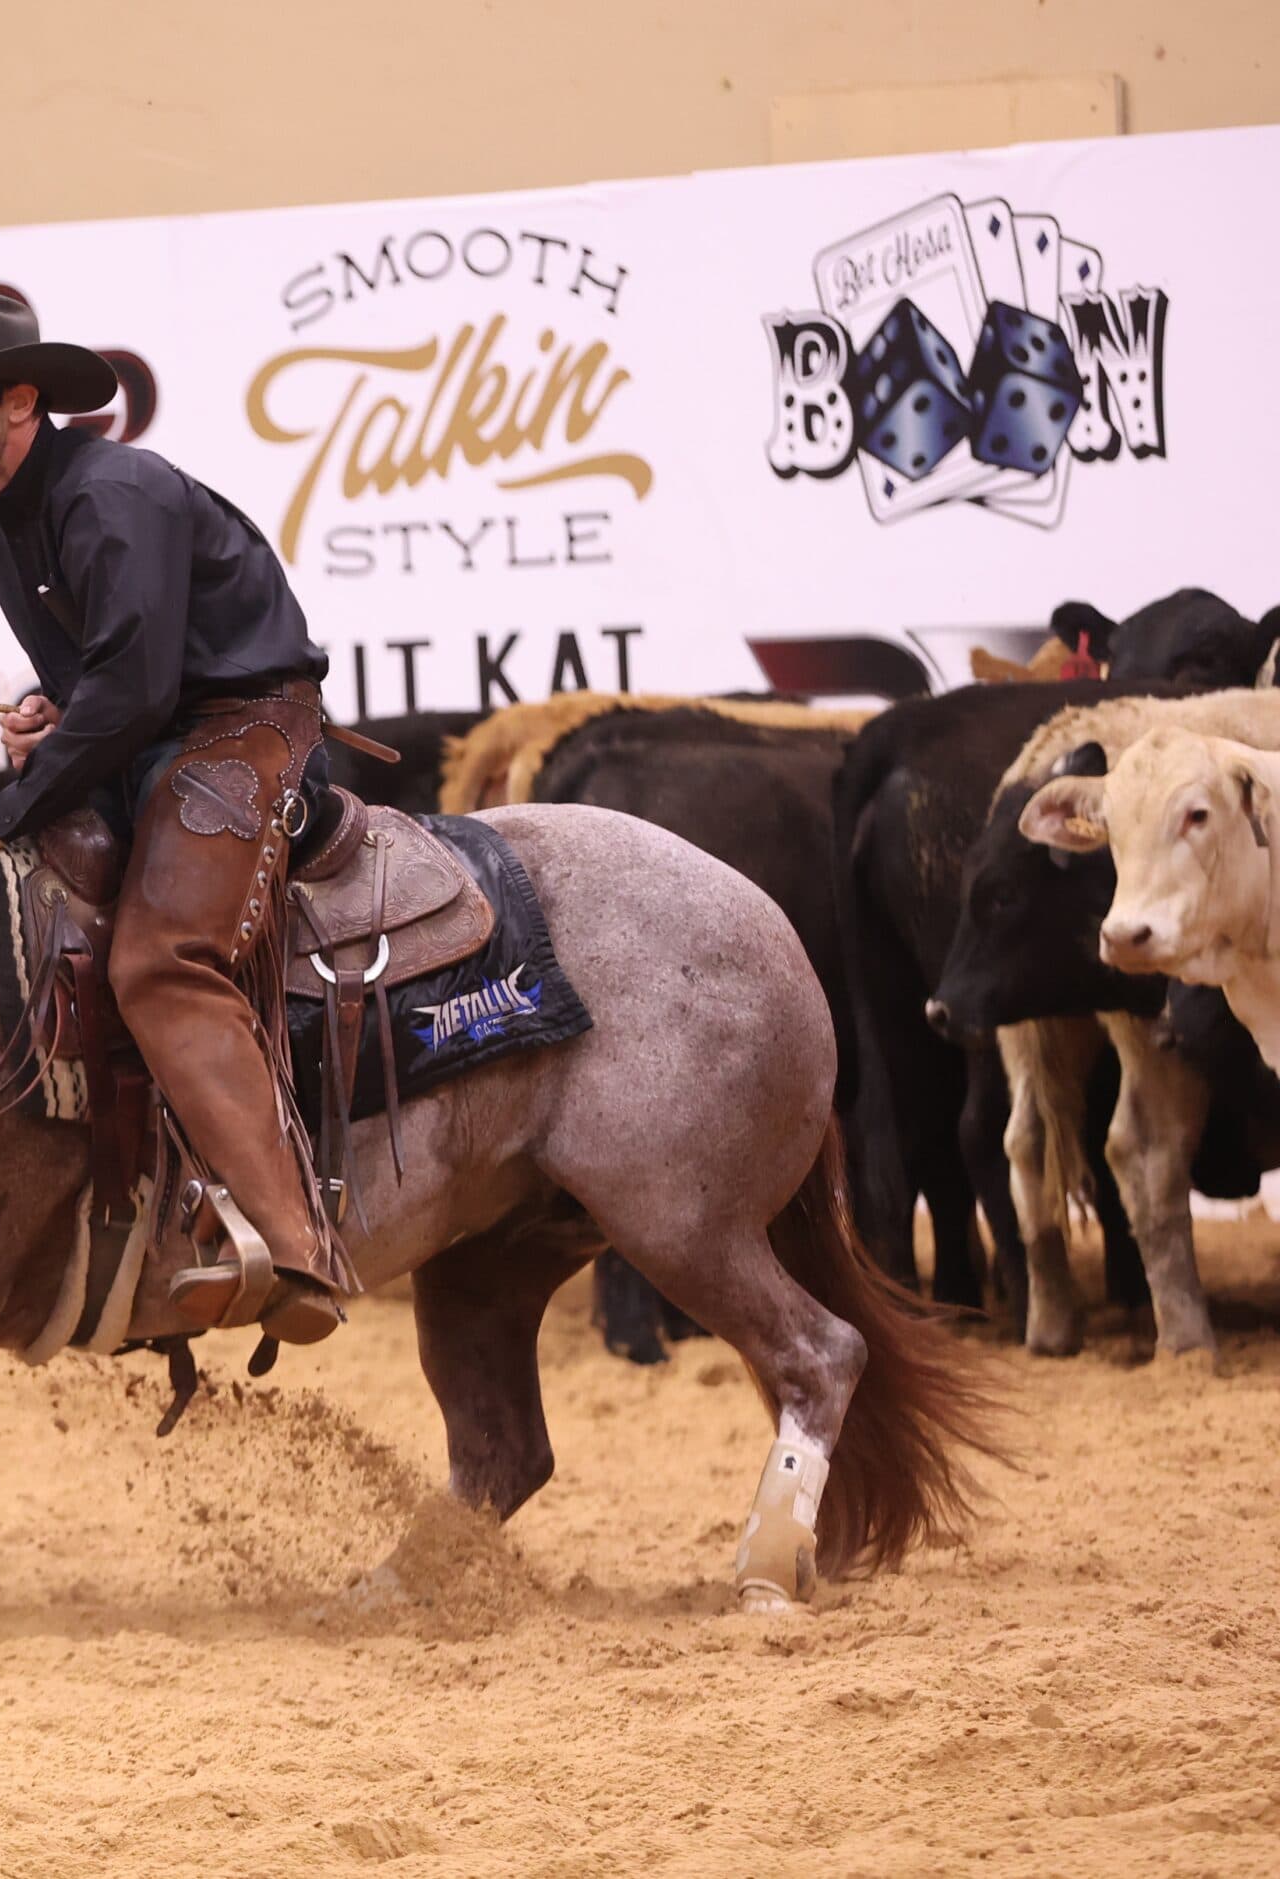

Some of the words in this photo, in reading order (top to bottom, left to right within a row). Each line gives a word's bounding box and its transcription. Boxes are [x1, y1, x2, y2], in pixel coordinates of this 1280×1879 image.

[281, 228, 628, 331] SMOOTH
[245, 311, 632, 566] Talkin
[325, 510, 613, 578] STYLE
[477, 627, 642, 714] KAT
[411, 961, 537, 1056] METALLIC
